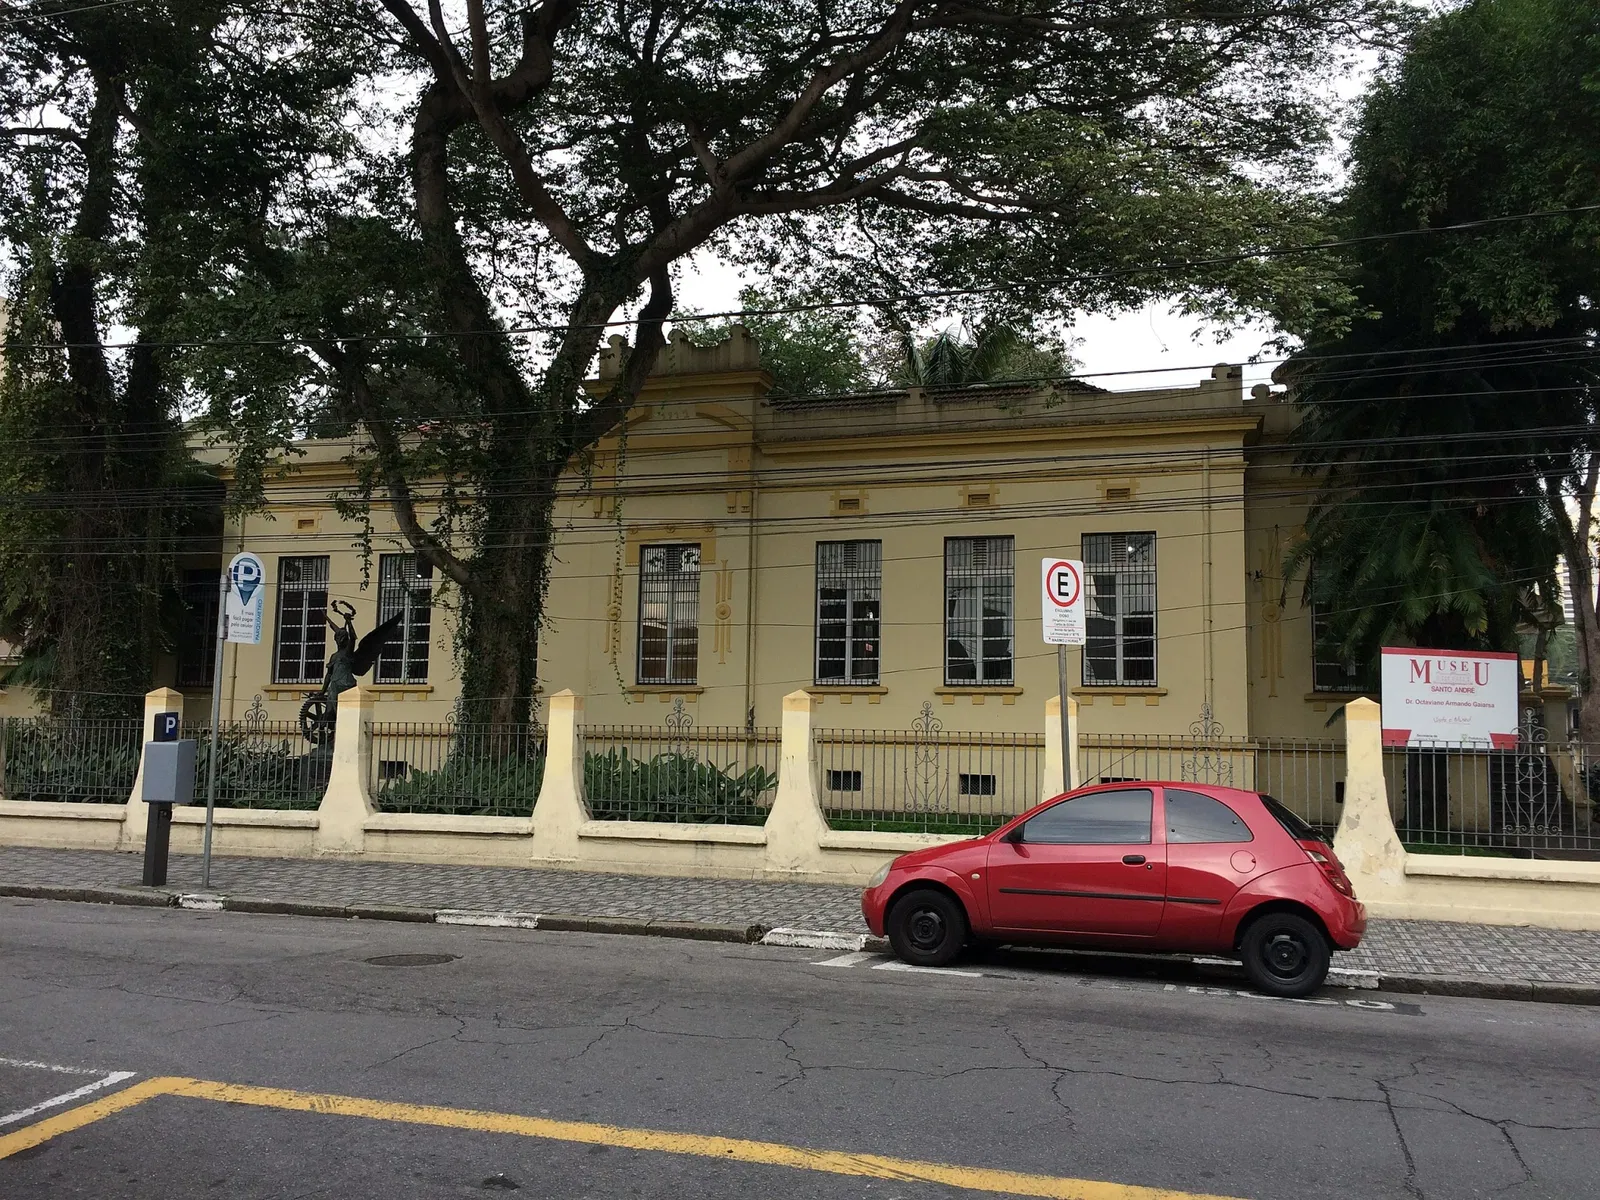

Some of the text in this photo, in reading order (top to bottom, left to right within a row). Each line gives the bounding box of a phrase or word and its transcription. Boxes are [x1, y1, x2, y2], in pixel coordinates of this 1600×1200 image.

[238, 561, 258, 588] P
[1057, 572, 1069, 596] E
[1409, 658, 1490, 686] MUSEU
[1431, 685, 1453, 693] SANTO
[1445, 700, 1472, 708] Armando
[165, 716, 176, 734] P
